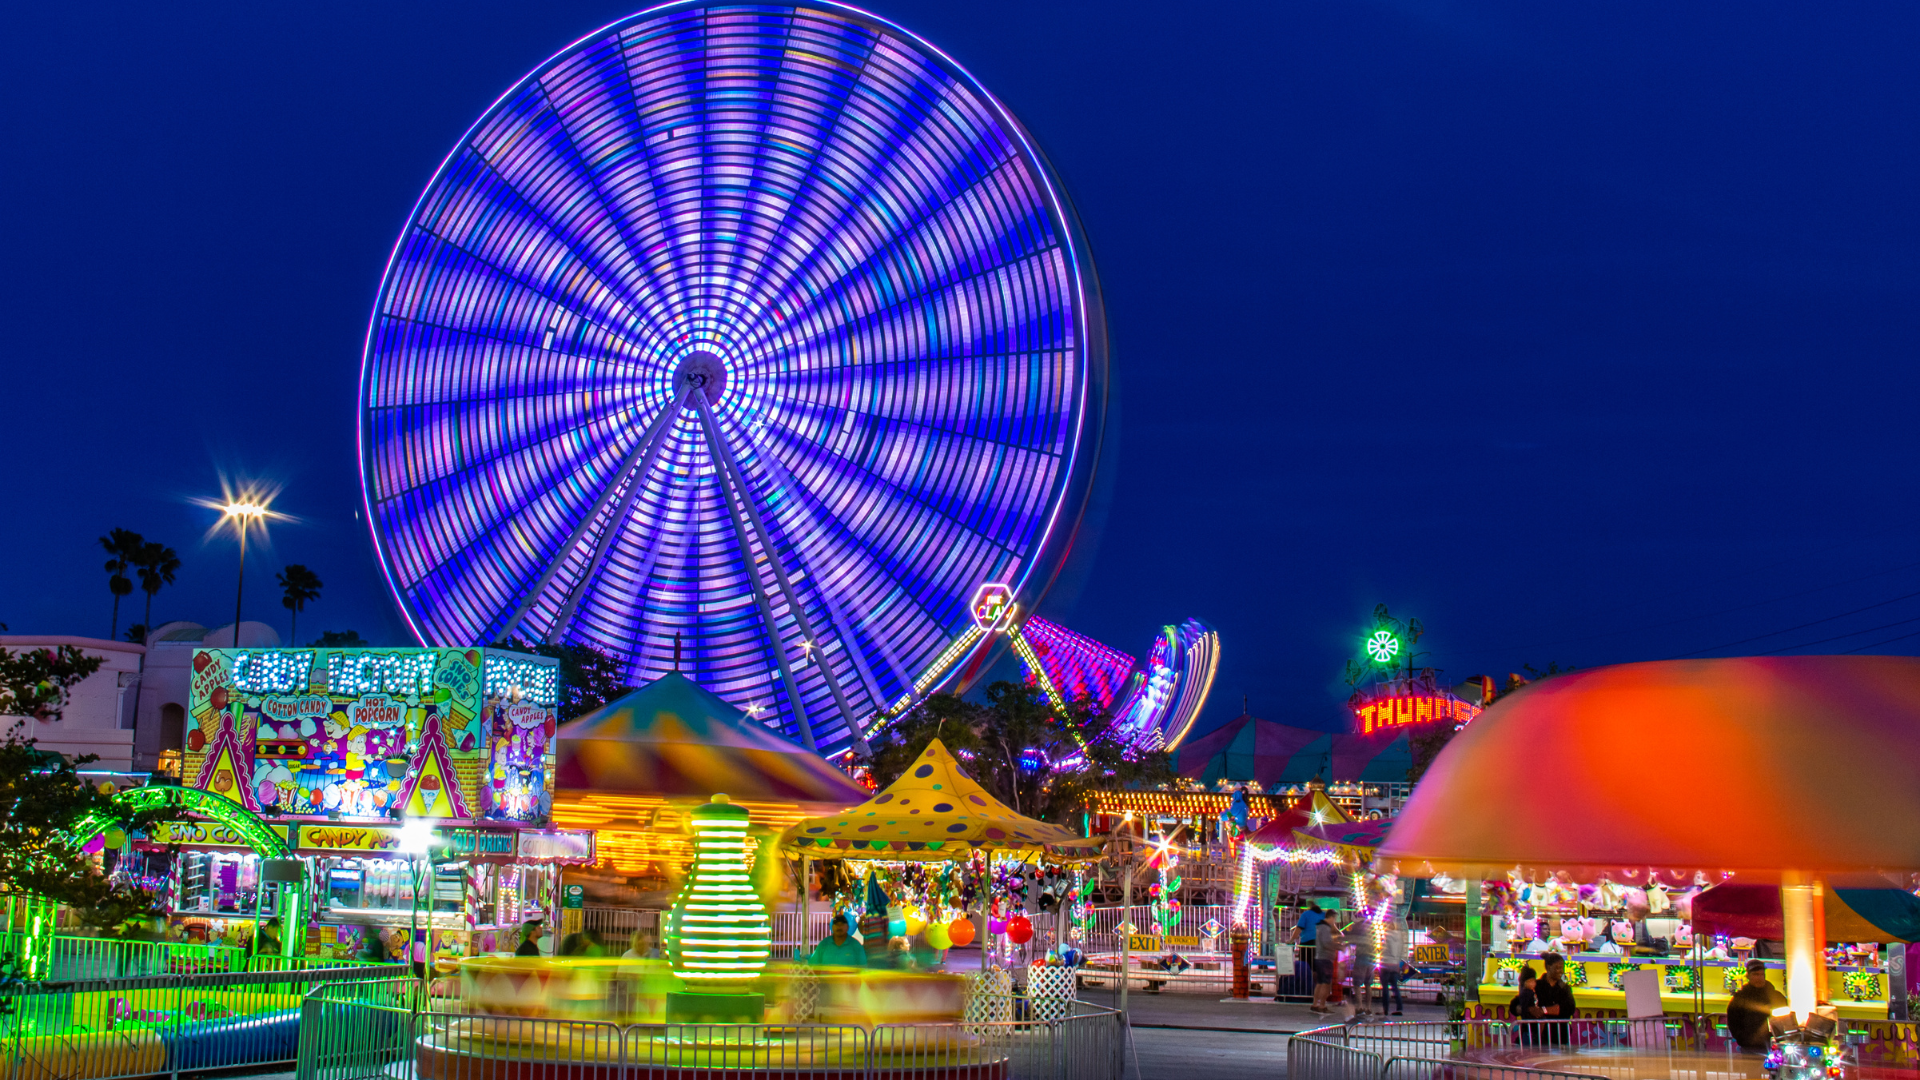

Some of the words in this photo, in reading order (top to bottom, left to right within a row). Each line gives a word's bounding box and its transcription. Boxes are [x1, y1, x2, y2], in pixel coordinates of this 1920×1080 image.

[194, 658, 222, 690] CANDY
[233, 649, 316, 694] CANDY
[327, 650, 440, 696] FACTORY
[451, 661, 472, 684] SNO
[485, 654, 558, 705] POPCORN
[199, 669, 229, 701] APPLES
[437, 668, 470, 701] CONES
[267, 699, 298, 717] COTTON
[300, 697, 327, 715] CANDY
[365, 698, 386, 708] HOT
[511, 706, 532, 717] CANDY
[355, 707, 400, 723] POPCORN
[521, 711, 544, 724] APPLES
[169, 824, 207, 842] SNO
[307, 827, 367, 849] CANDY
[479, 833, 513, 853] DRINKS
[1129, 936, 1156, 951] EXIT
[1416, 945, 1448, 961] ENTER
